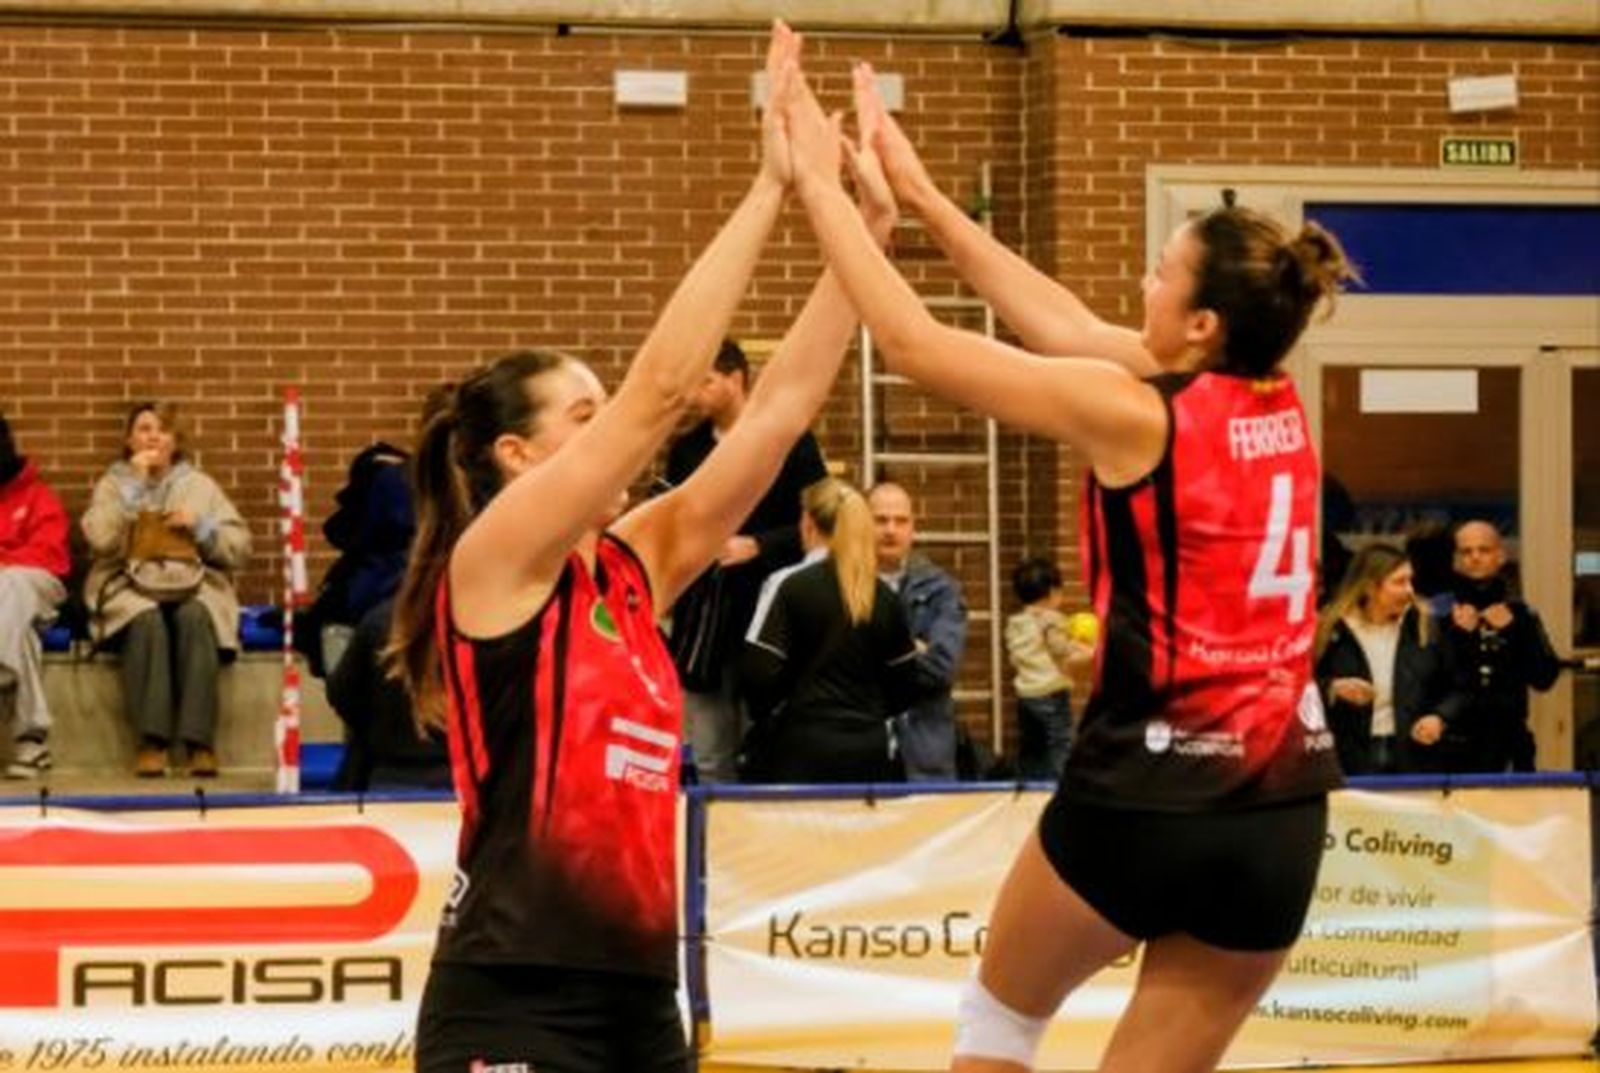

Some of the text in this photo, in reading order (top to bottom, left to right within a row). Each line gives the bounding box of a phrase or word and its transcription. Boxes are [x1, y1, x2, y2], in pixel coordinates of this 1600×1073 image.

[1446, 142, 1512, 163] SALIDA
[1247, 472, 1313, 624] 4
[1345, 827, 1453, 865] Coliving
[767, 911, 931, 960] Kanso
[73, 956, 402, 1006] ACISA
[1286, 957, 1419, 982] ulticultural
[25, 1037, 114, 1070] 1975
